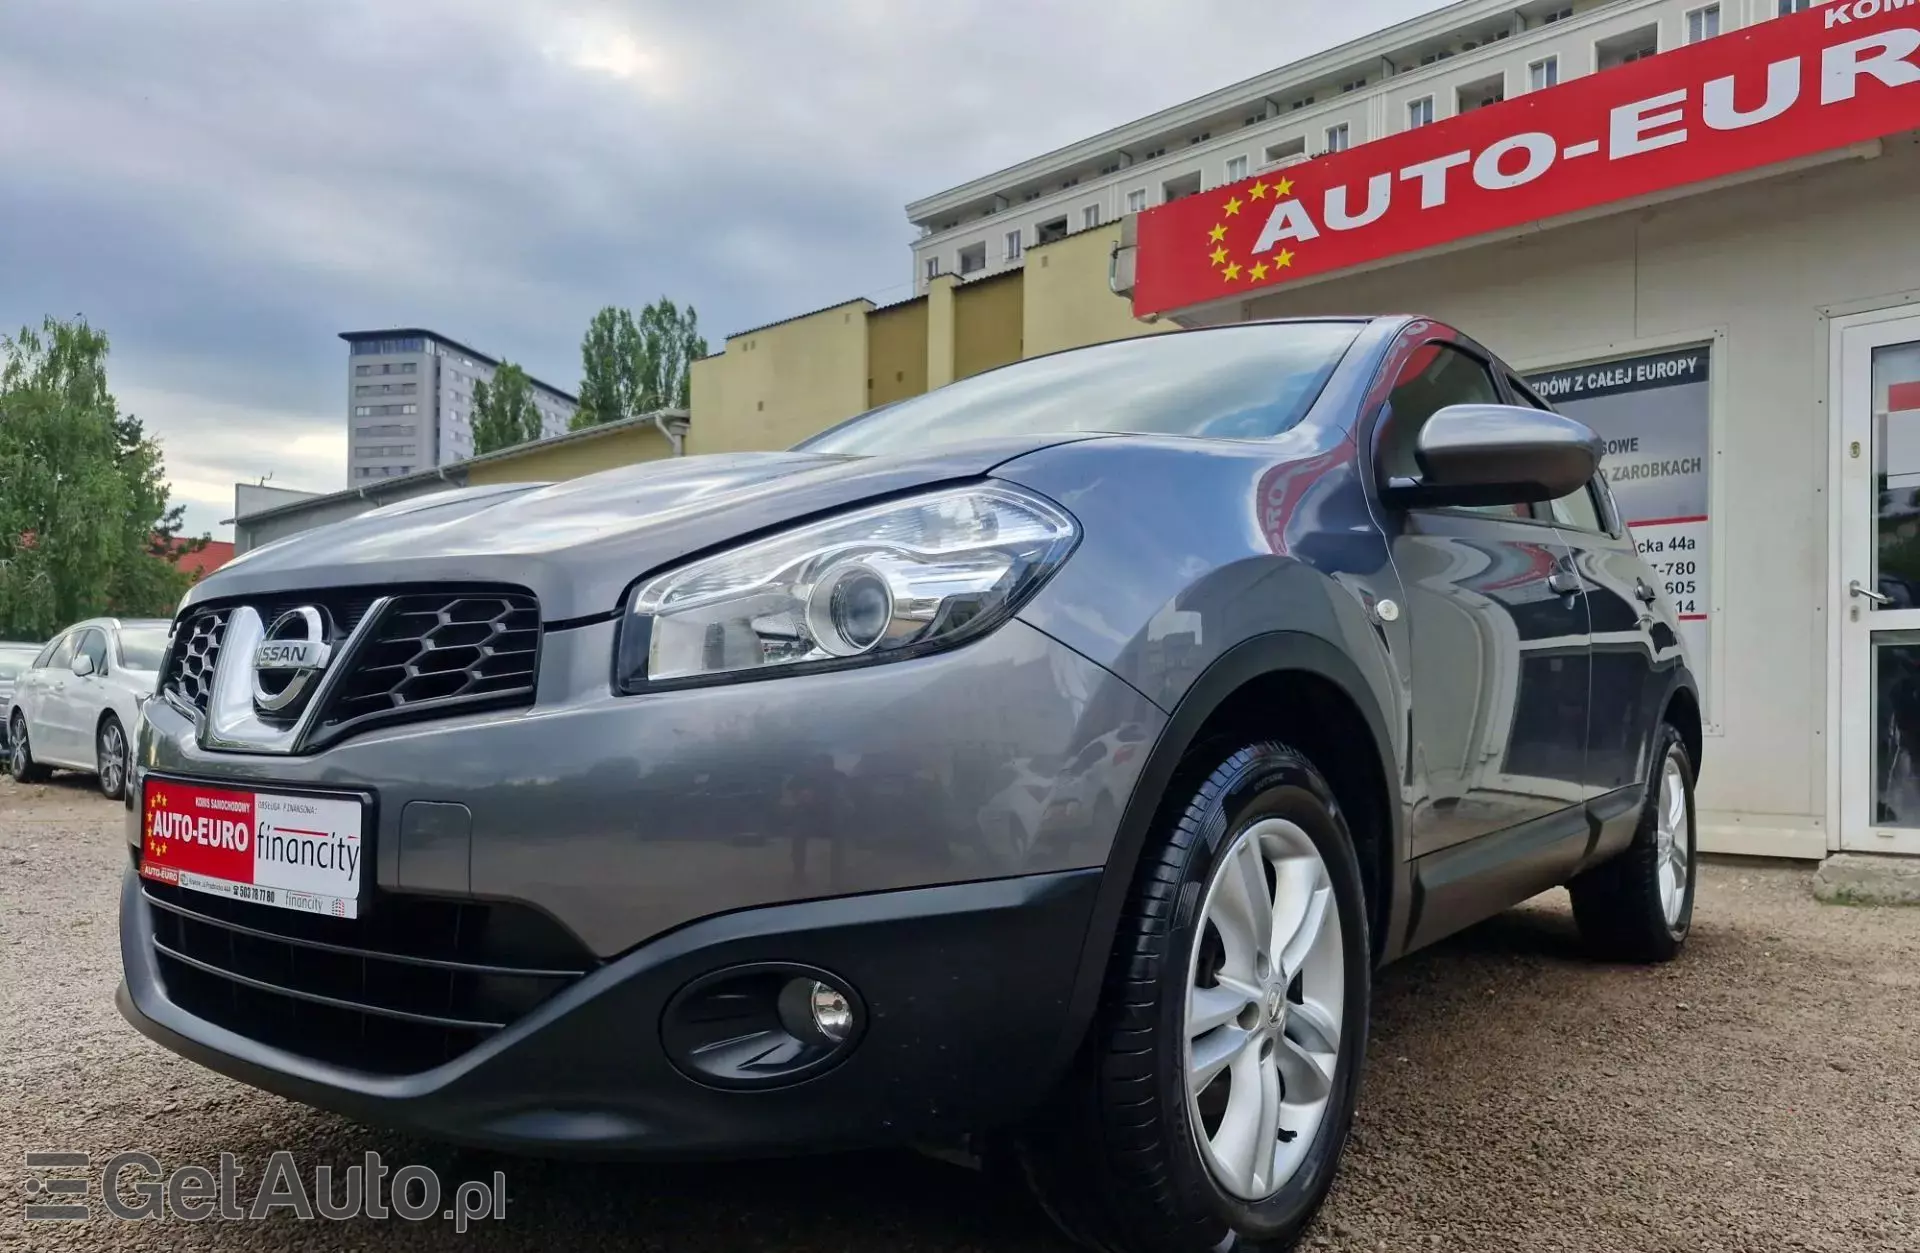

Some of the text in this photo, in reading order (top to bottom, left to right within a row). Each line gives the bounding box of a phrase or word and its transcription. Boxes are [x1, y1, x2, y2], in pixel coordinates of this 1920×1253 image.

[1574, 375, 1584, 392] Z
[1587, 367, 1632, 389] CAŁEJ
[1636, 356, 1697, 382] EUROPY
[1612, 457, 1701, 482] ZAROBKACH
[1668, 536, 1695, 550] 44a
[1665, 581, 1695, 594] 605
[1676, 600, 1695, 612] 14
[211, 798, 250, 813] SAMOCHODOWY
[153, 810, 249, 851] AUTO-EURO
[257, 821, 360, 881] financity
[145, 866, 178, 881] AUTO-EURO
[266, 890, 275, 903] 80
[285, 890, 324, 913] financity
